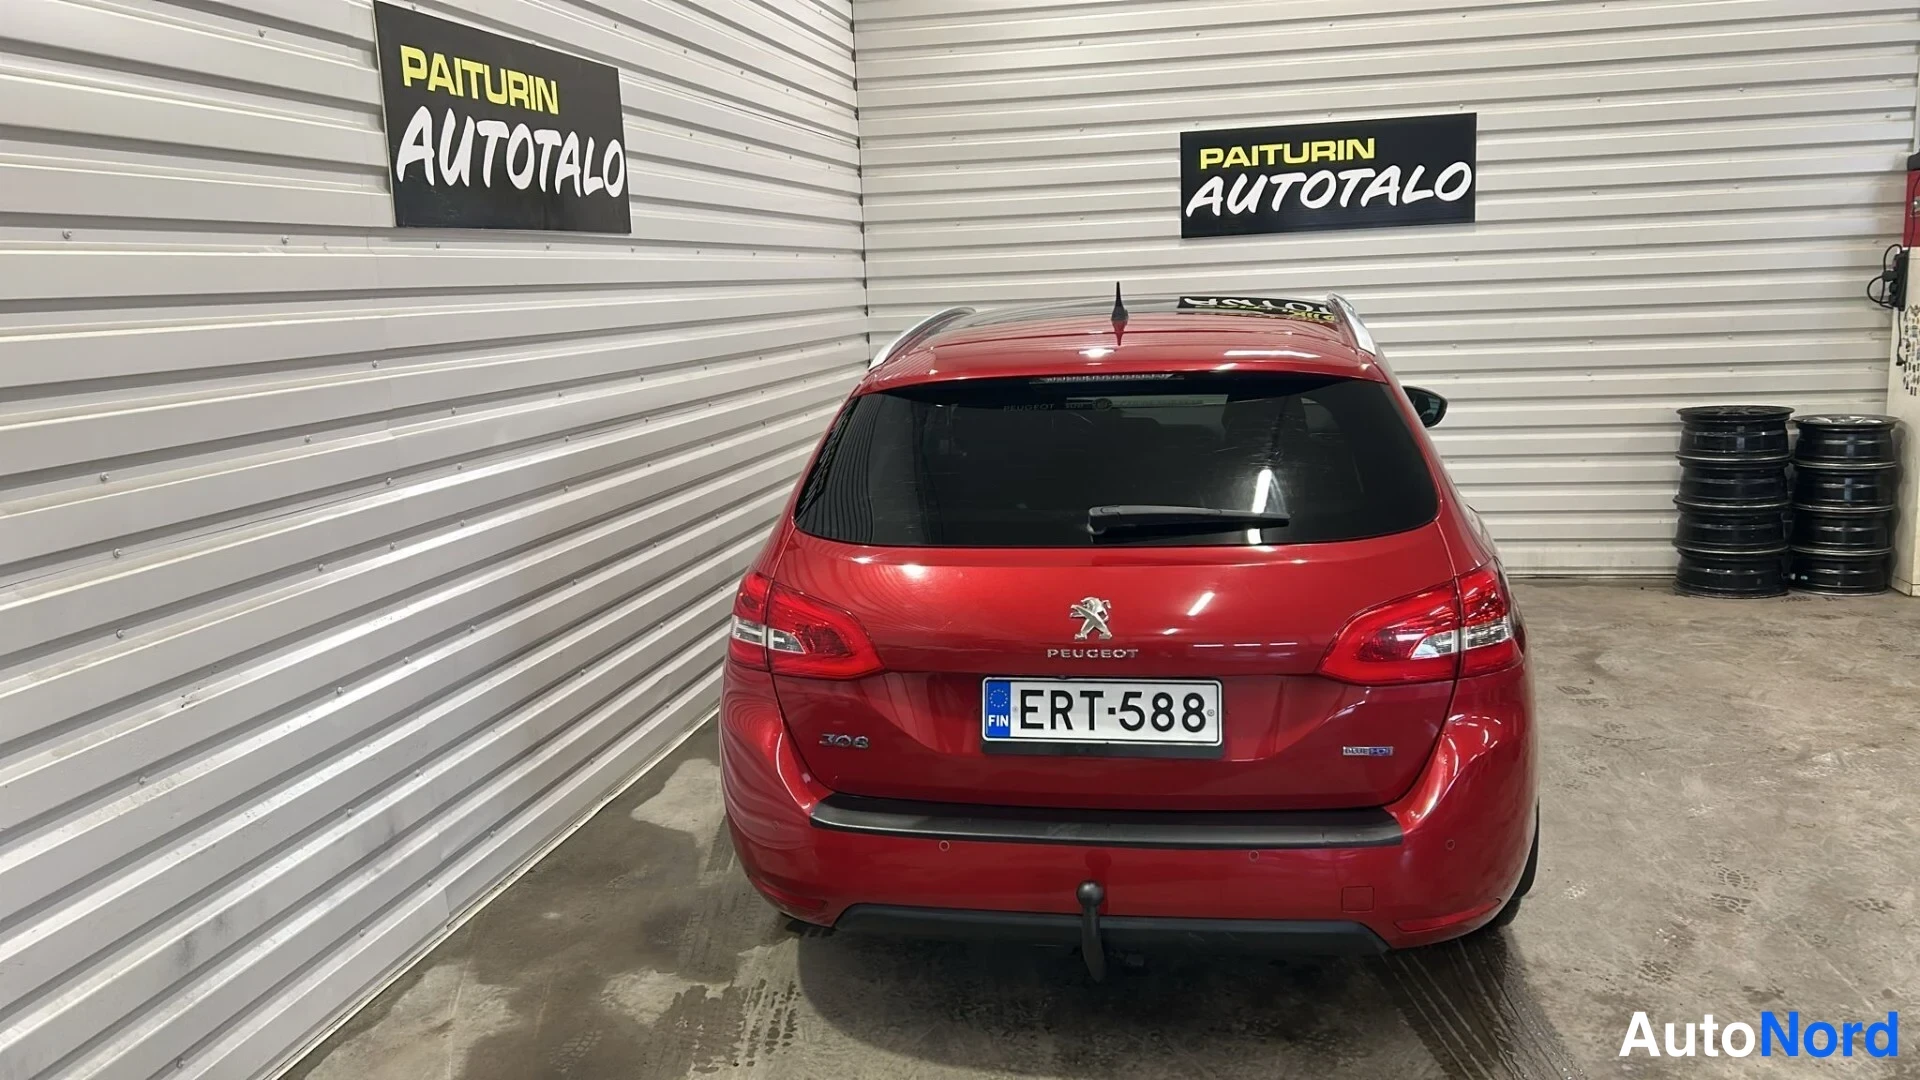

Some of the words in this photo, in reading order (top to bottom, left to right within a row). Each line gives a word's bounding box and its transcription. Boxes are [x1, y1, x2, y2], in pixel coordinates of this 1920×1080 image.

[400, 45, 559, 115] PAITURIN
[396, 105, 625, 198] AUTOTALO
[1200, 137, 1375, 169] PAITURIN
[1185, 161, 1473, 217] AUTOTALO
[1003, 403, 1055, 412] PEUGEOT
[1047, 649, 1139, 658] PEUGEOT
[988, 714, 1009, 727] FIN
[1020, 690, 1206, 733] ERT-588
[819, 733, 869, 749] 308
